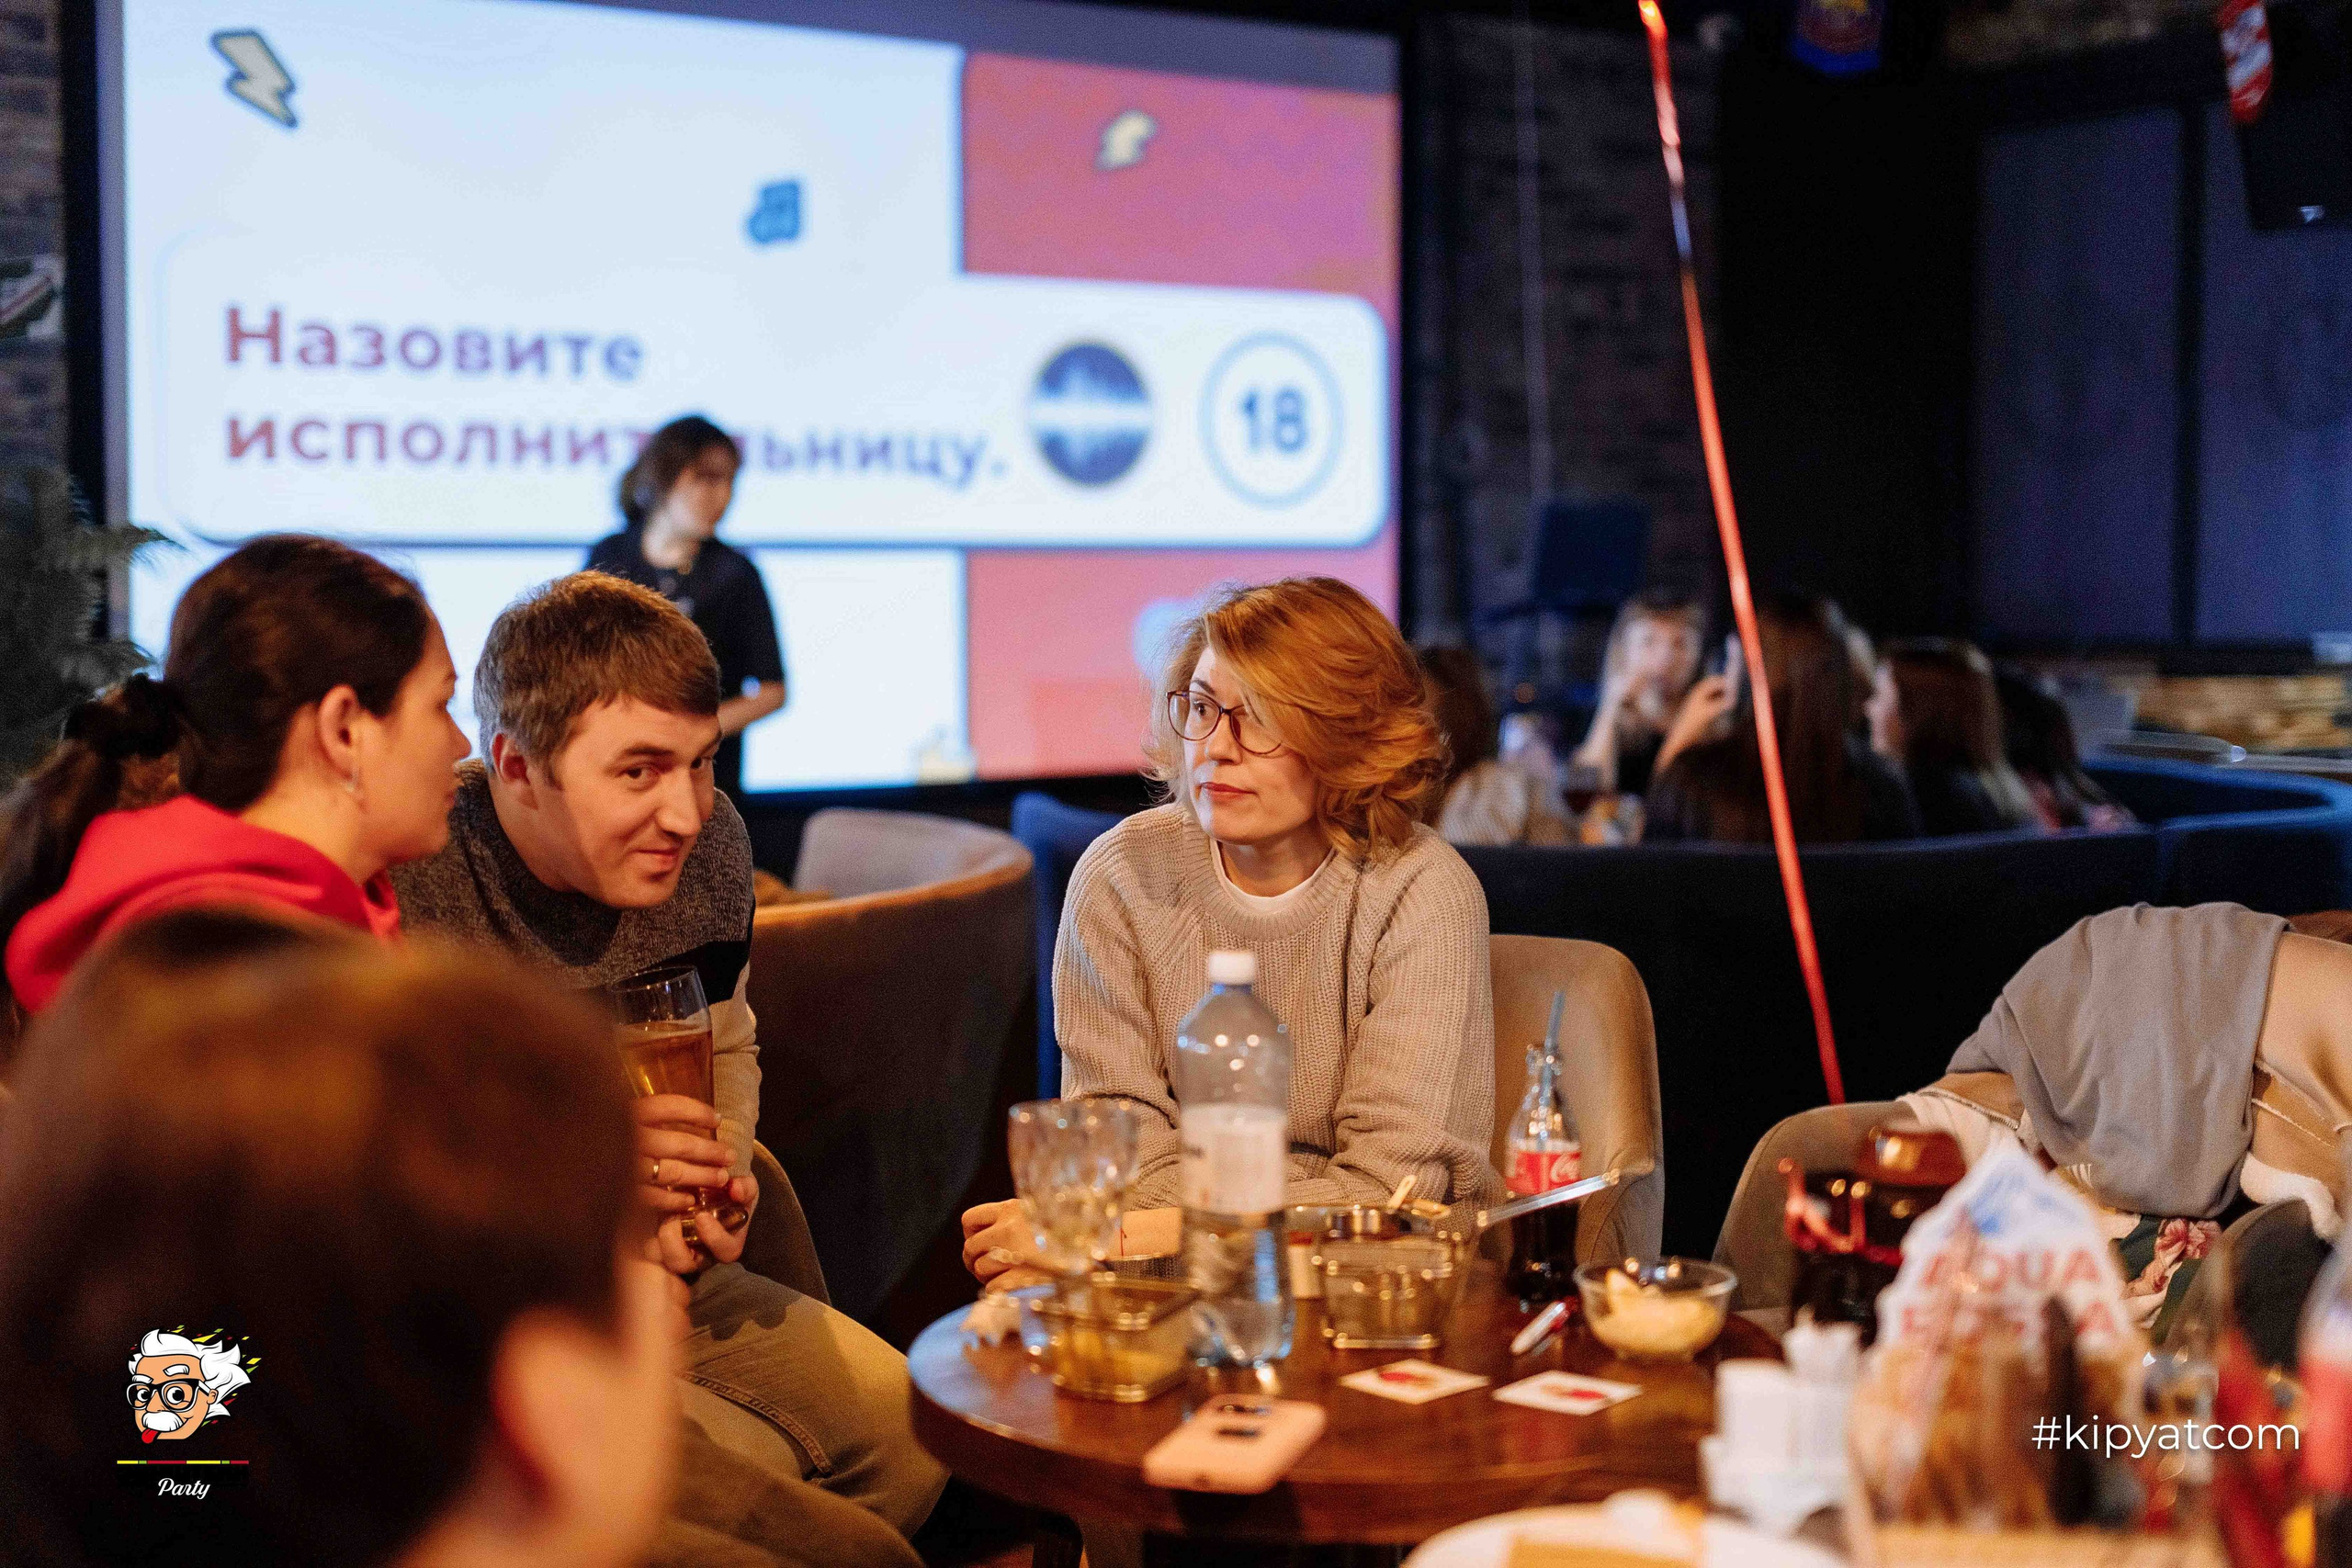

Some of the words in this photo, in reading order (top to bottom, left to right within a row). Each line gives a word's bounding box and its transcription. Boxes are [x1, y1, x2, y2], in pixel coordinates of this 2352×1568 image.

[225, 305, 644, 379] Назовите
[226, 416, 1007, 490] исполнитьницу.
[1240, 386, 1308, 455] 18
